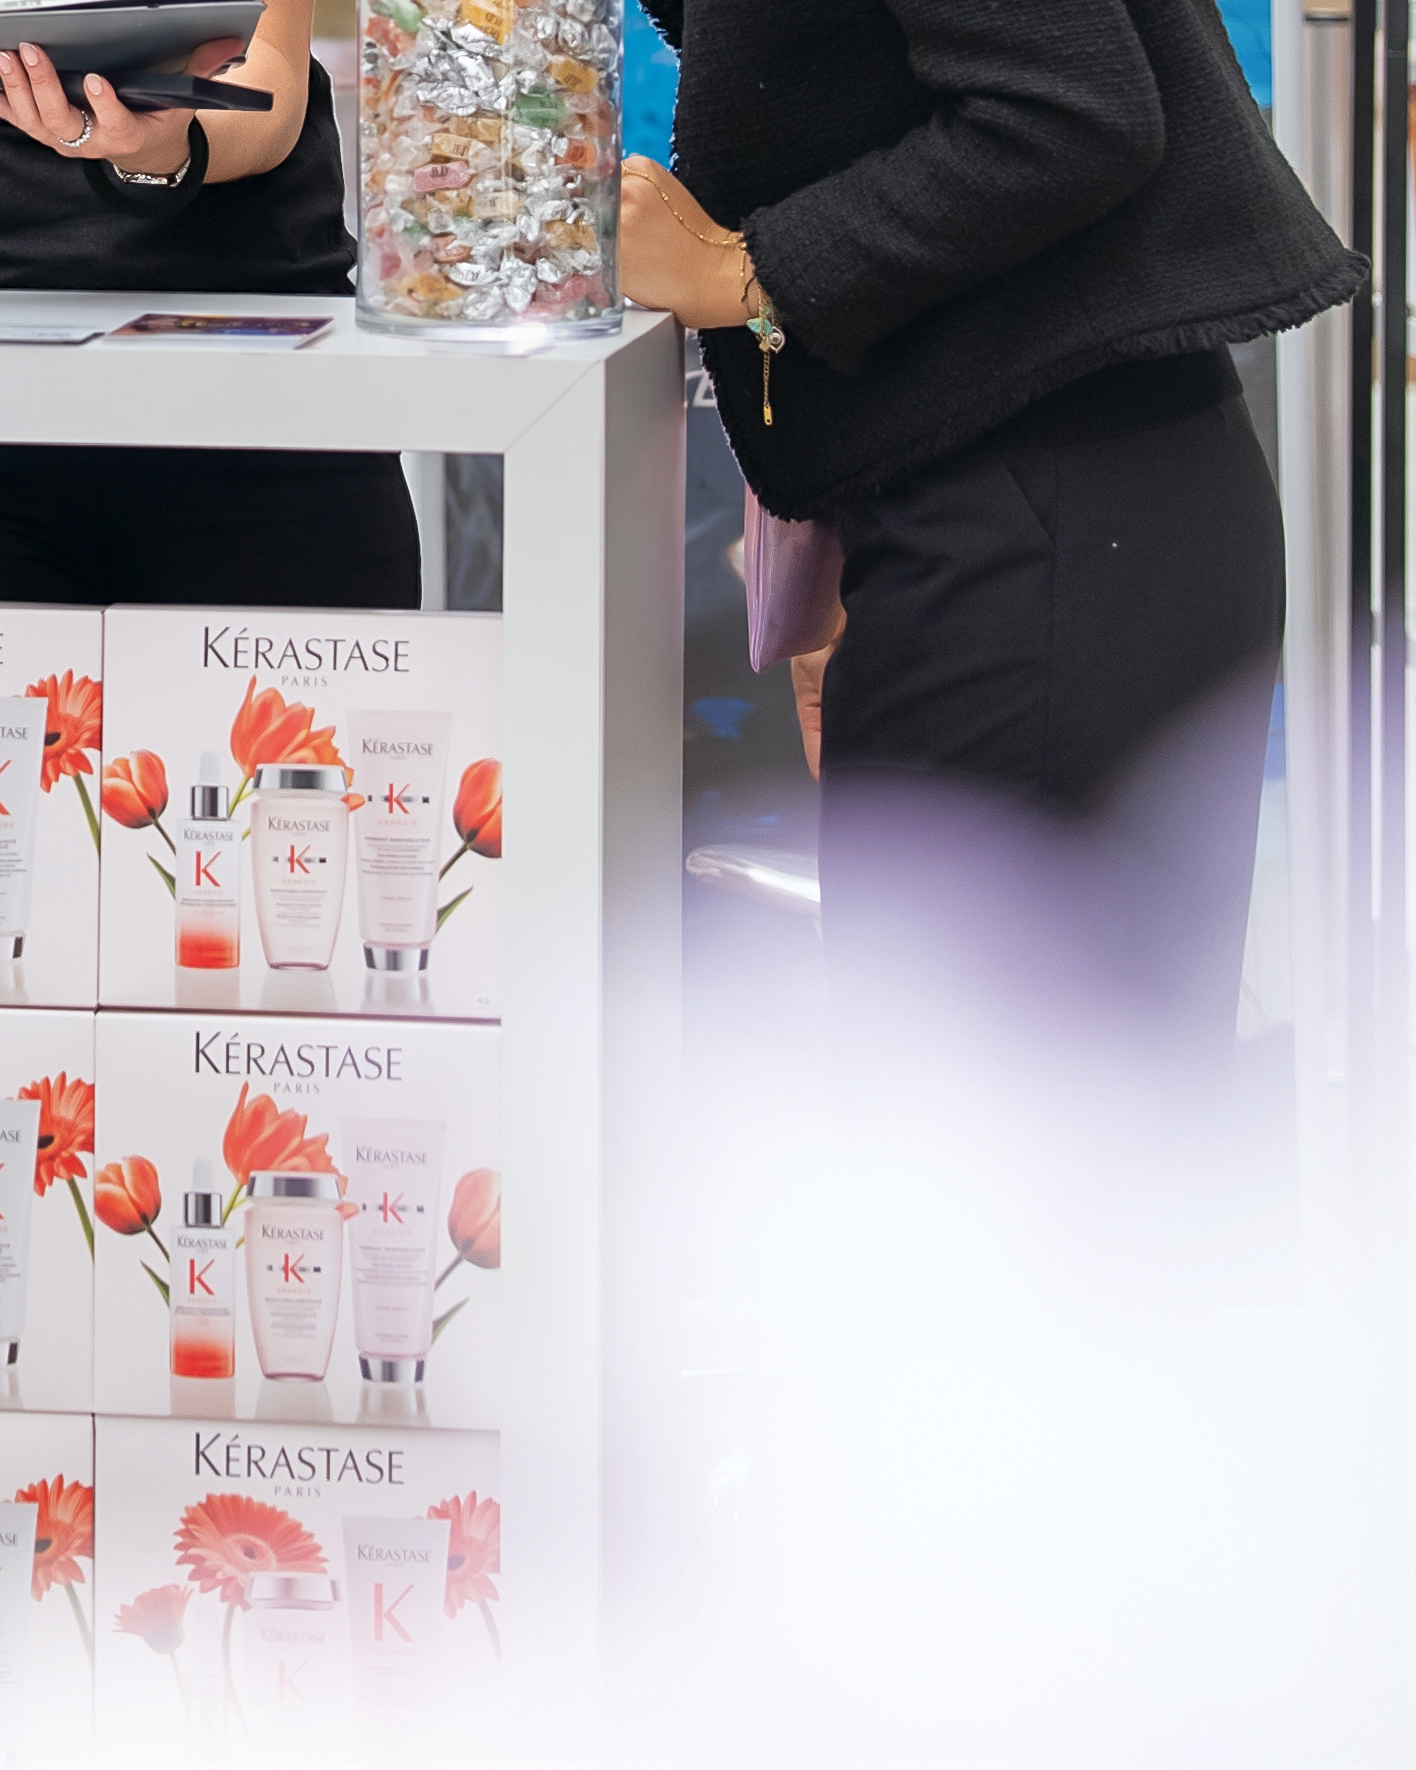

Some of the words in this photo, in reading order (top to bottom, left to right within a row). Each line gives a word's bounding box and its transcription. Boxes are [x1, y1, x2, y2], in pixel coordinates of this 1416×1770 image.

[203, 626, 410, 672] KÉRASTASE
[281, 676, 328, 687] PARIS
[363, 739, 434, 756] KÉRASTASE
[388, 783, 410, 814] K
[184, 828, 233, 841] KÉRASTASE
[268, 816, 330, 832] KÉRASTASE
[196, 851, 221, 887] K
[290, 845, 311, 874] K
[194, 1031, 402, 1081] KÉRASTASE
[273, 1082, 321, 1094] PARIS
[356, 1145, 427, 1164] KÉRASTASE
[383, 1191, 404, 1224] K
[177, 1235, 227, 1249] KÉRASTASE
[262, 1224, 324, 1240] KÉRASTASE
[189, 1258, 215, 1295] K
[284, 1254, 305, 1283] K
[195, 1432, 404, 1485] KÉRASTASE
[274, 1486, 322, 1498] PARIS
[358, 1544, 431, 1563] KÉRASTASE
[374, 1582, 415, 1642] K
